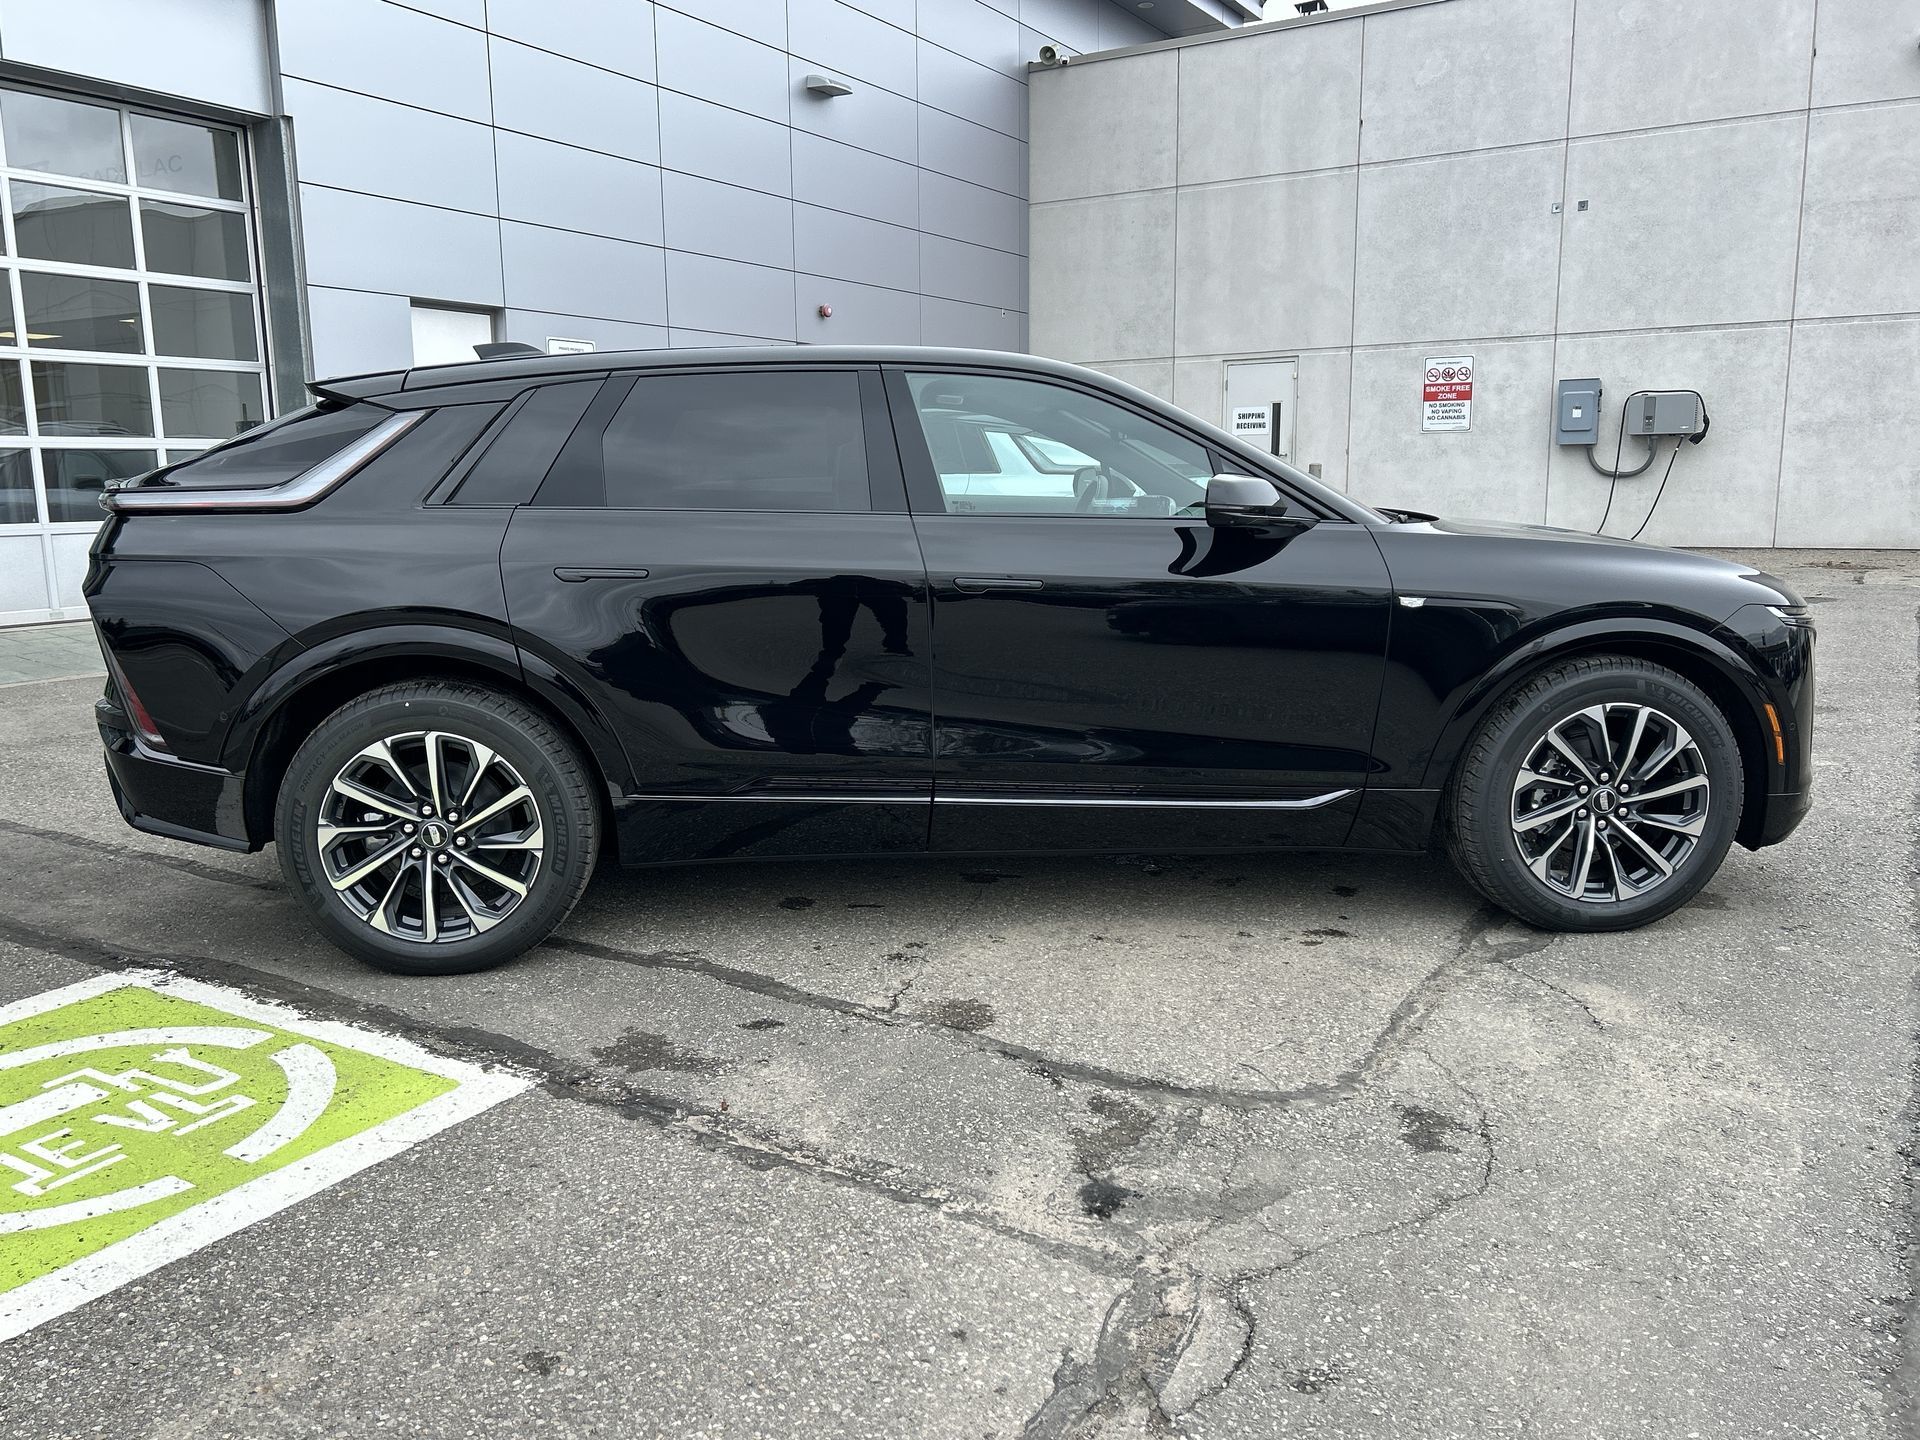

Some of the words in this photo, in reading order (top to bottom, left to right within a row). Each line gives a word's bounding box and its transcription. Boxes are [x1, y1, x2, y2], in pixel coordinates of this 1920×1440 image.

[1236, 421, 1266, 429] RECEIVING
[1237, 412, 1265, 420] SHIPPING
[1667, 691, 1723, 746] MICHELIN
[290, 799, 313, 884] MICHELIN
[549, 794, 567, 874] MICHELIN
